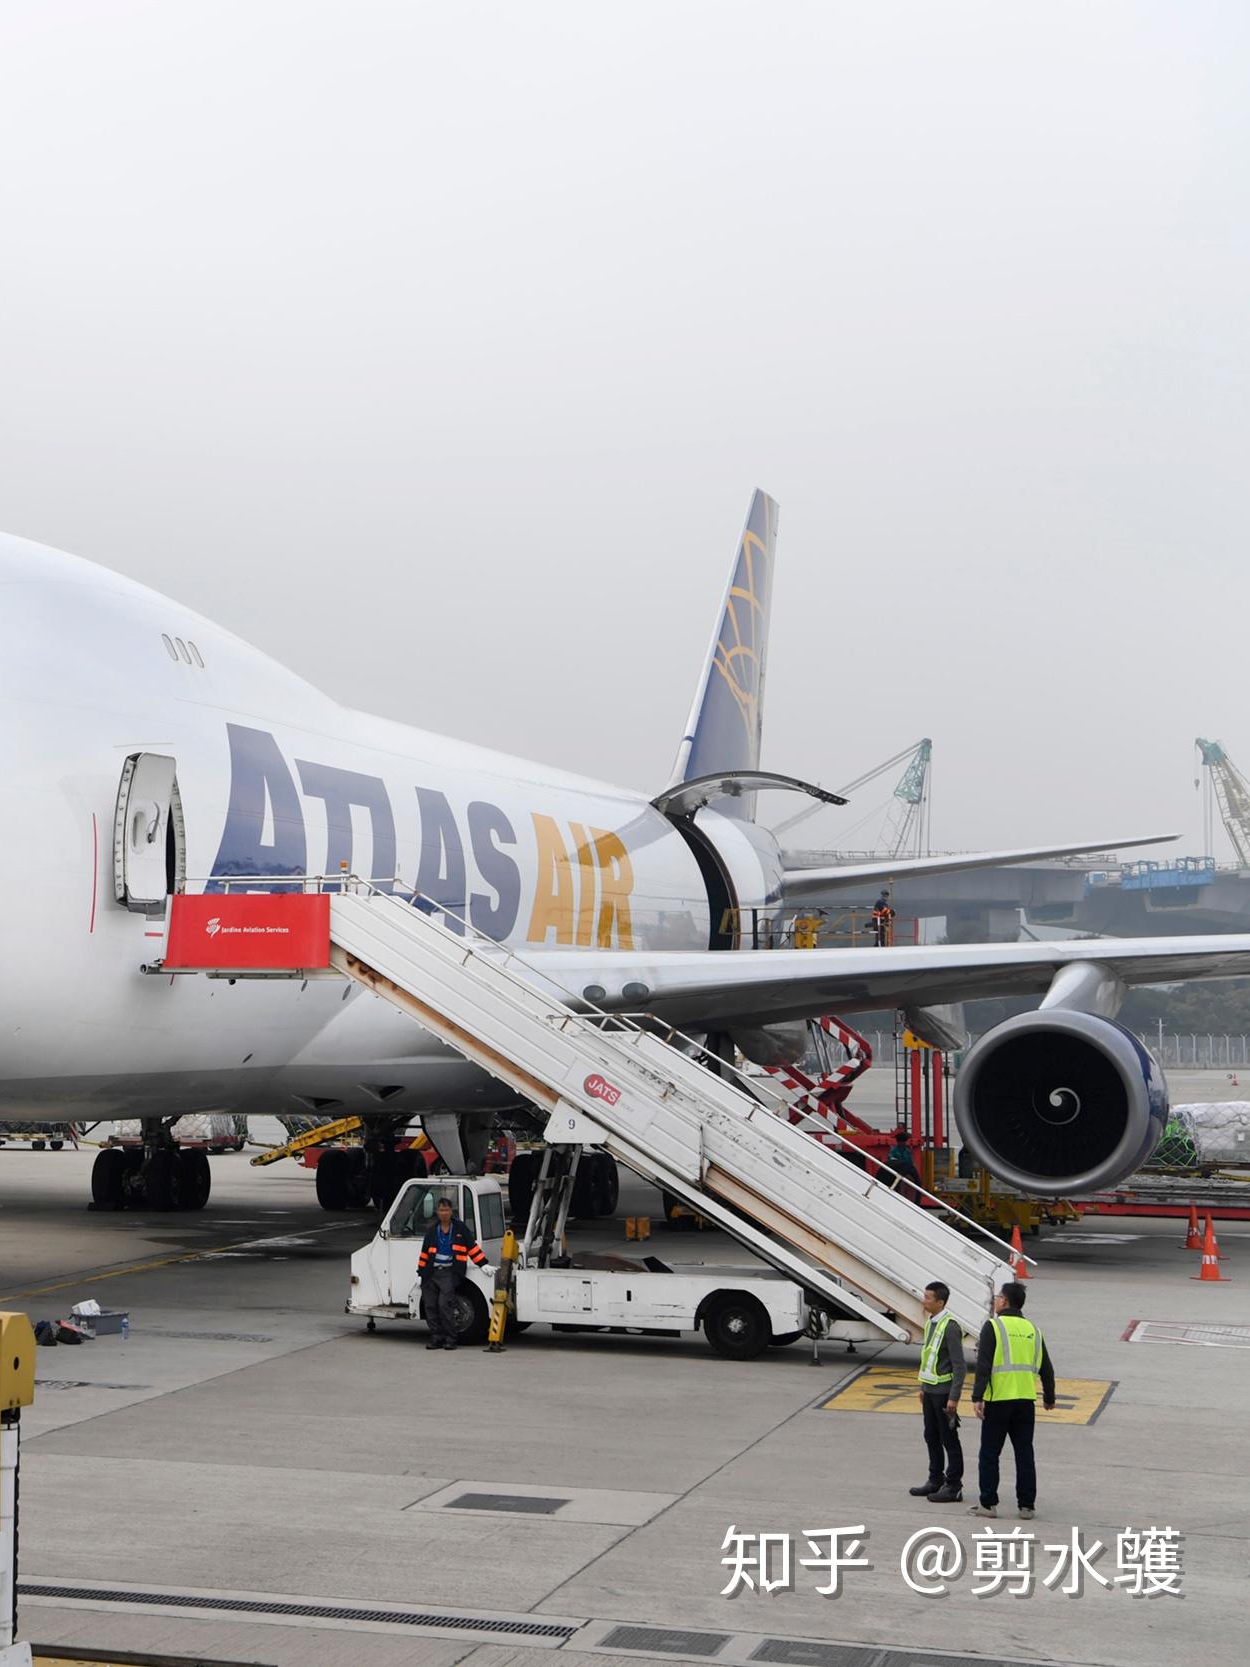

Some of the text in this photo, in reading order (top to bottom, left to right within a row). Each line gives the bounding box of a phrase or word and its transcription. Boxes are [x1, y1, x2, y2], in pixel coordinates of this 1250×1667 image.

[202, 722, 634, 951] ATLAS AIR
[222, 926, 289, 934] Jardine Aviation Services
[588, 1080, 618, 1102] JATS
[568, 1119, 576, 1130] 9
